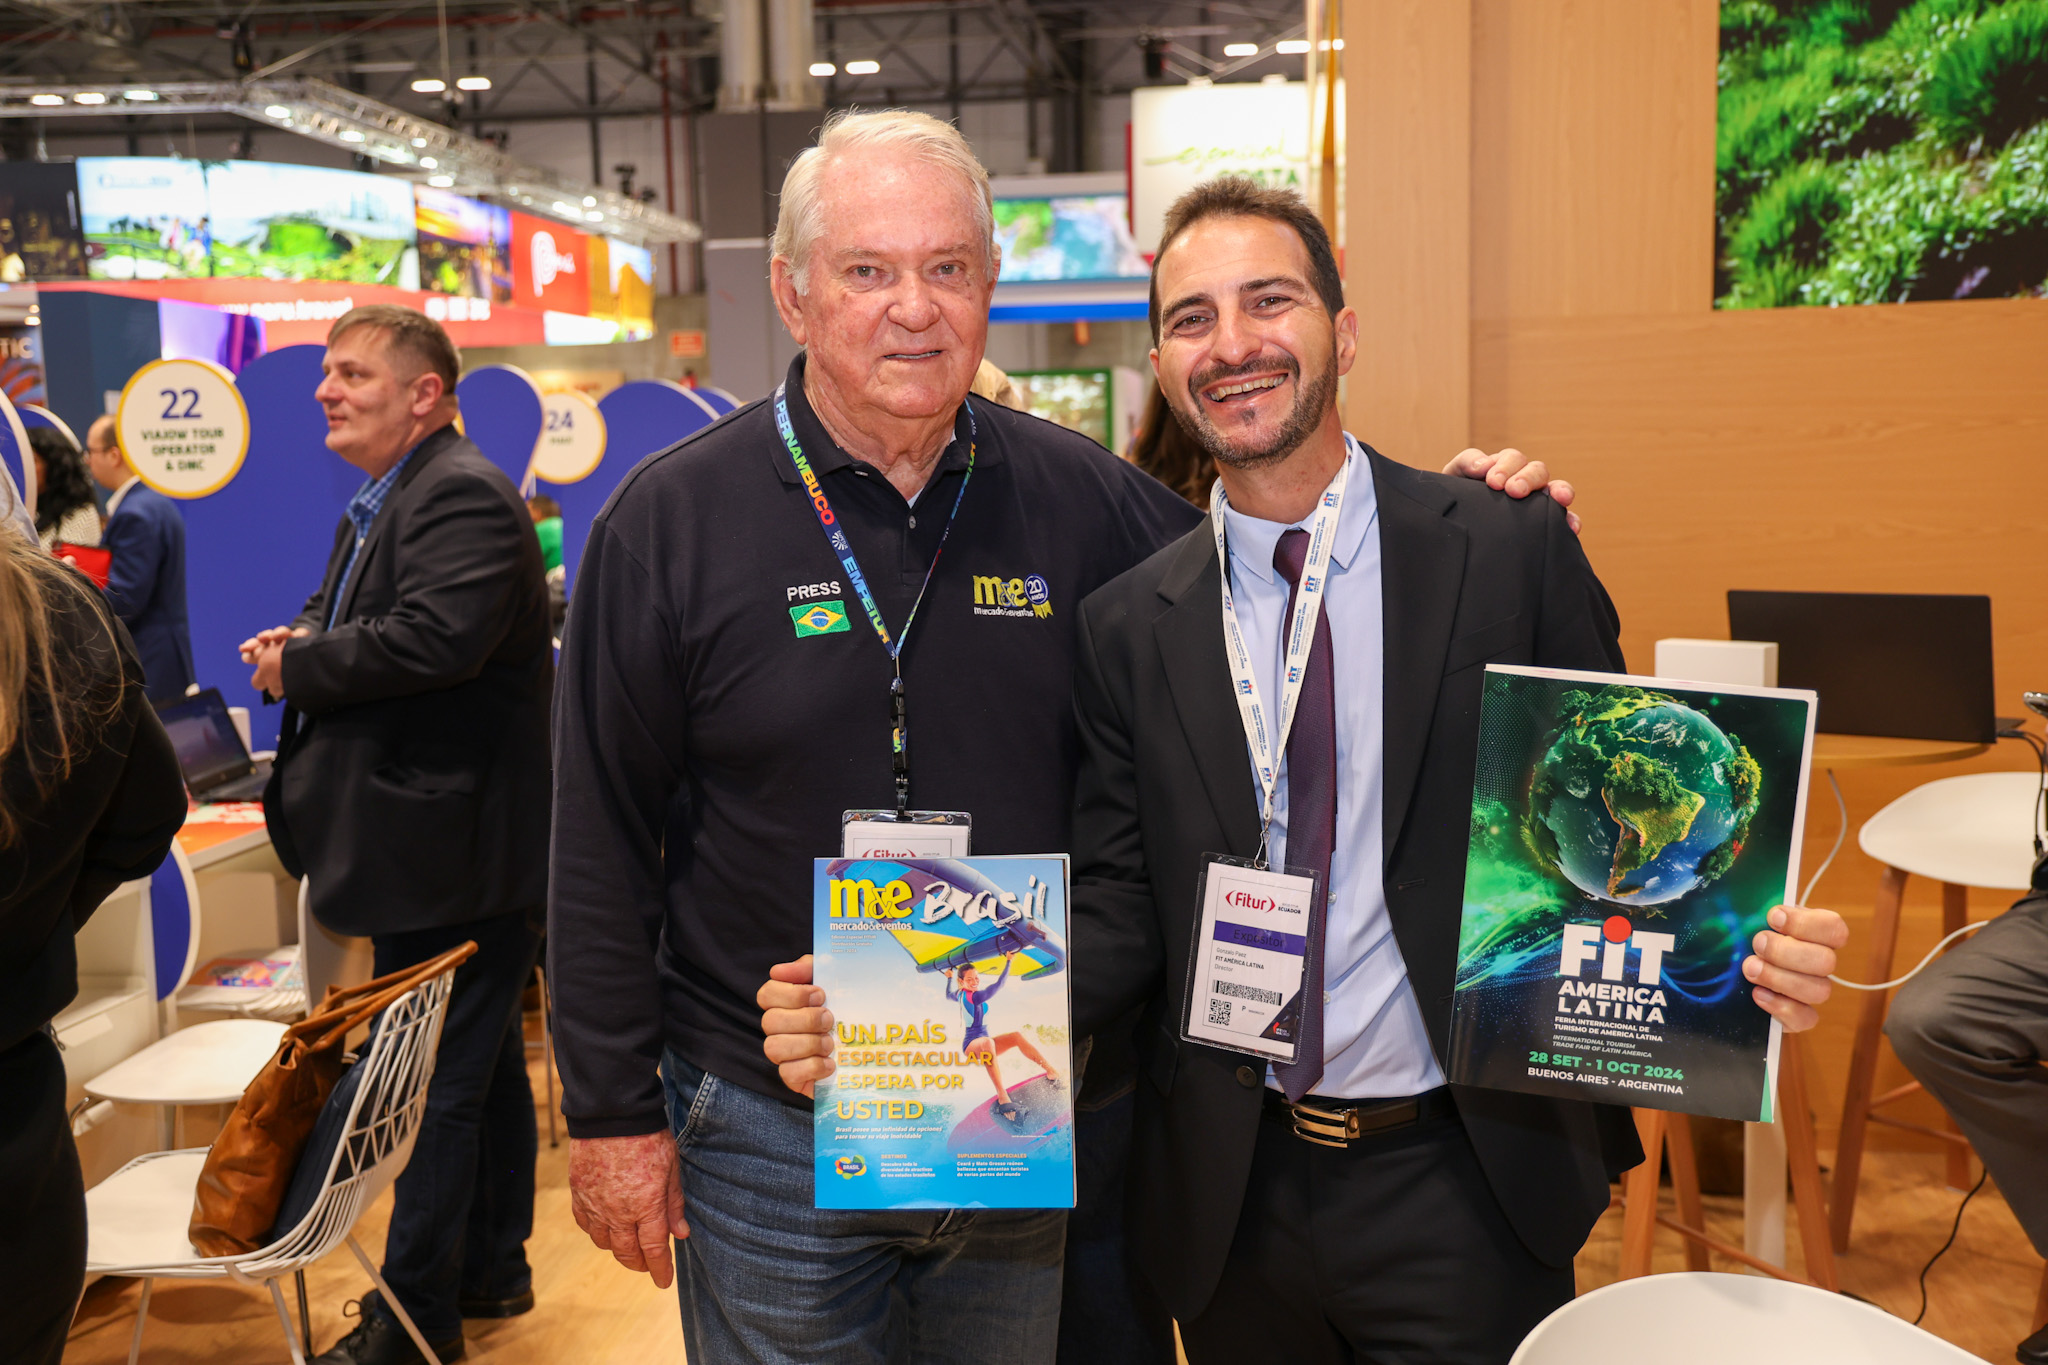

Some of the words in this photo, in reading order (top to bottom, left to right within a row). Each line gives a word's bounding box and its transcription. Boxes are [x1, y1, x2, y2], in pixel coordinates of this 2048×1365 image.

[160, 389, 202, 418] 22
[546, 410, 573, 430] 24
[192, 428, 224, 438] TOUR
[152, 444, 216, 456] OPERATOR
[776, 400, 835, 526] PERNAMBUCO
[787, 581, 841, 601] PRESS
[1028, 580, 1042, 594] 20
[842, 556, 890, 644] EMPETUR
[829, 879, 913, 920] m&e
[920, 875, 1047, 928] Brasil
[1235, 892, 1267, 910] Fitur
[830, 921, 912, 932] mercado&eventos
[1234, 929, 1284, 947] Expositor
[1246, 960, 1264, 970] LATINA
[1558, 980, 1667, 1007] AMERICA
[1558, 997, 1665, 1024] LATINA
[838, 1023, 876, 1043] UN
[886, 1019, 946, 1044] PAÍS
[1554, 1024, 1587, 1034] TURISMO
[1600, 1028, 1634, 1039] AMERICA
[1636, 1032, 1663, 1042] LATINA
[1555, 1016, 1576, 1025] FERIA
[1578, 1018, 1637, 1032] INTERNACIONAL
[1552, 1034, 1605, 1046] INTERNATIONAL
[1606, 1040, 1636, 1049] TOURISM
[838, 1051, 993, 1066] ESPECTACULAR
[1622, 1049, 1652, 1058] AMERICA
[1528, 1051, 1548, 1064] 28
[1552, 1054, 1582, 1067] SET
[1596, 1059, 1602, 1070] 1
[1606, 1060, 1641, 1075] OCT
[1644, 1065, 1684, 1080] 2024
[837, 1074, 915, 1089] ESPERA
[921, 1074, 964, 1089] POR
[1528, 1067, 1574, 1080] BUENOS
[1576, 1073, 1609, 1085] AIRES
[1618, 1079, 1683, 1095] ARGENTINA
[837, 1100, 924, 1120] USTED
